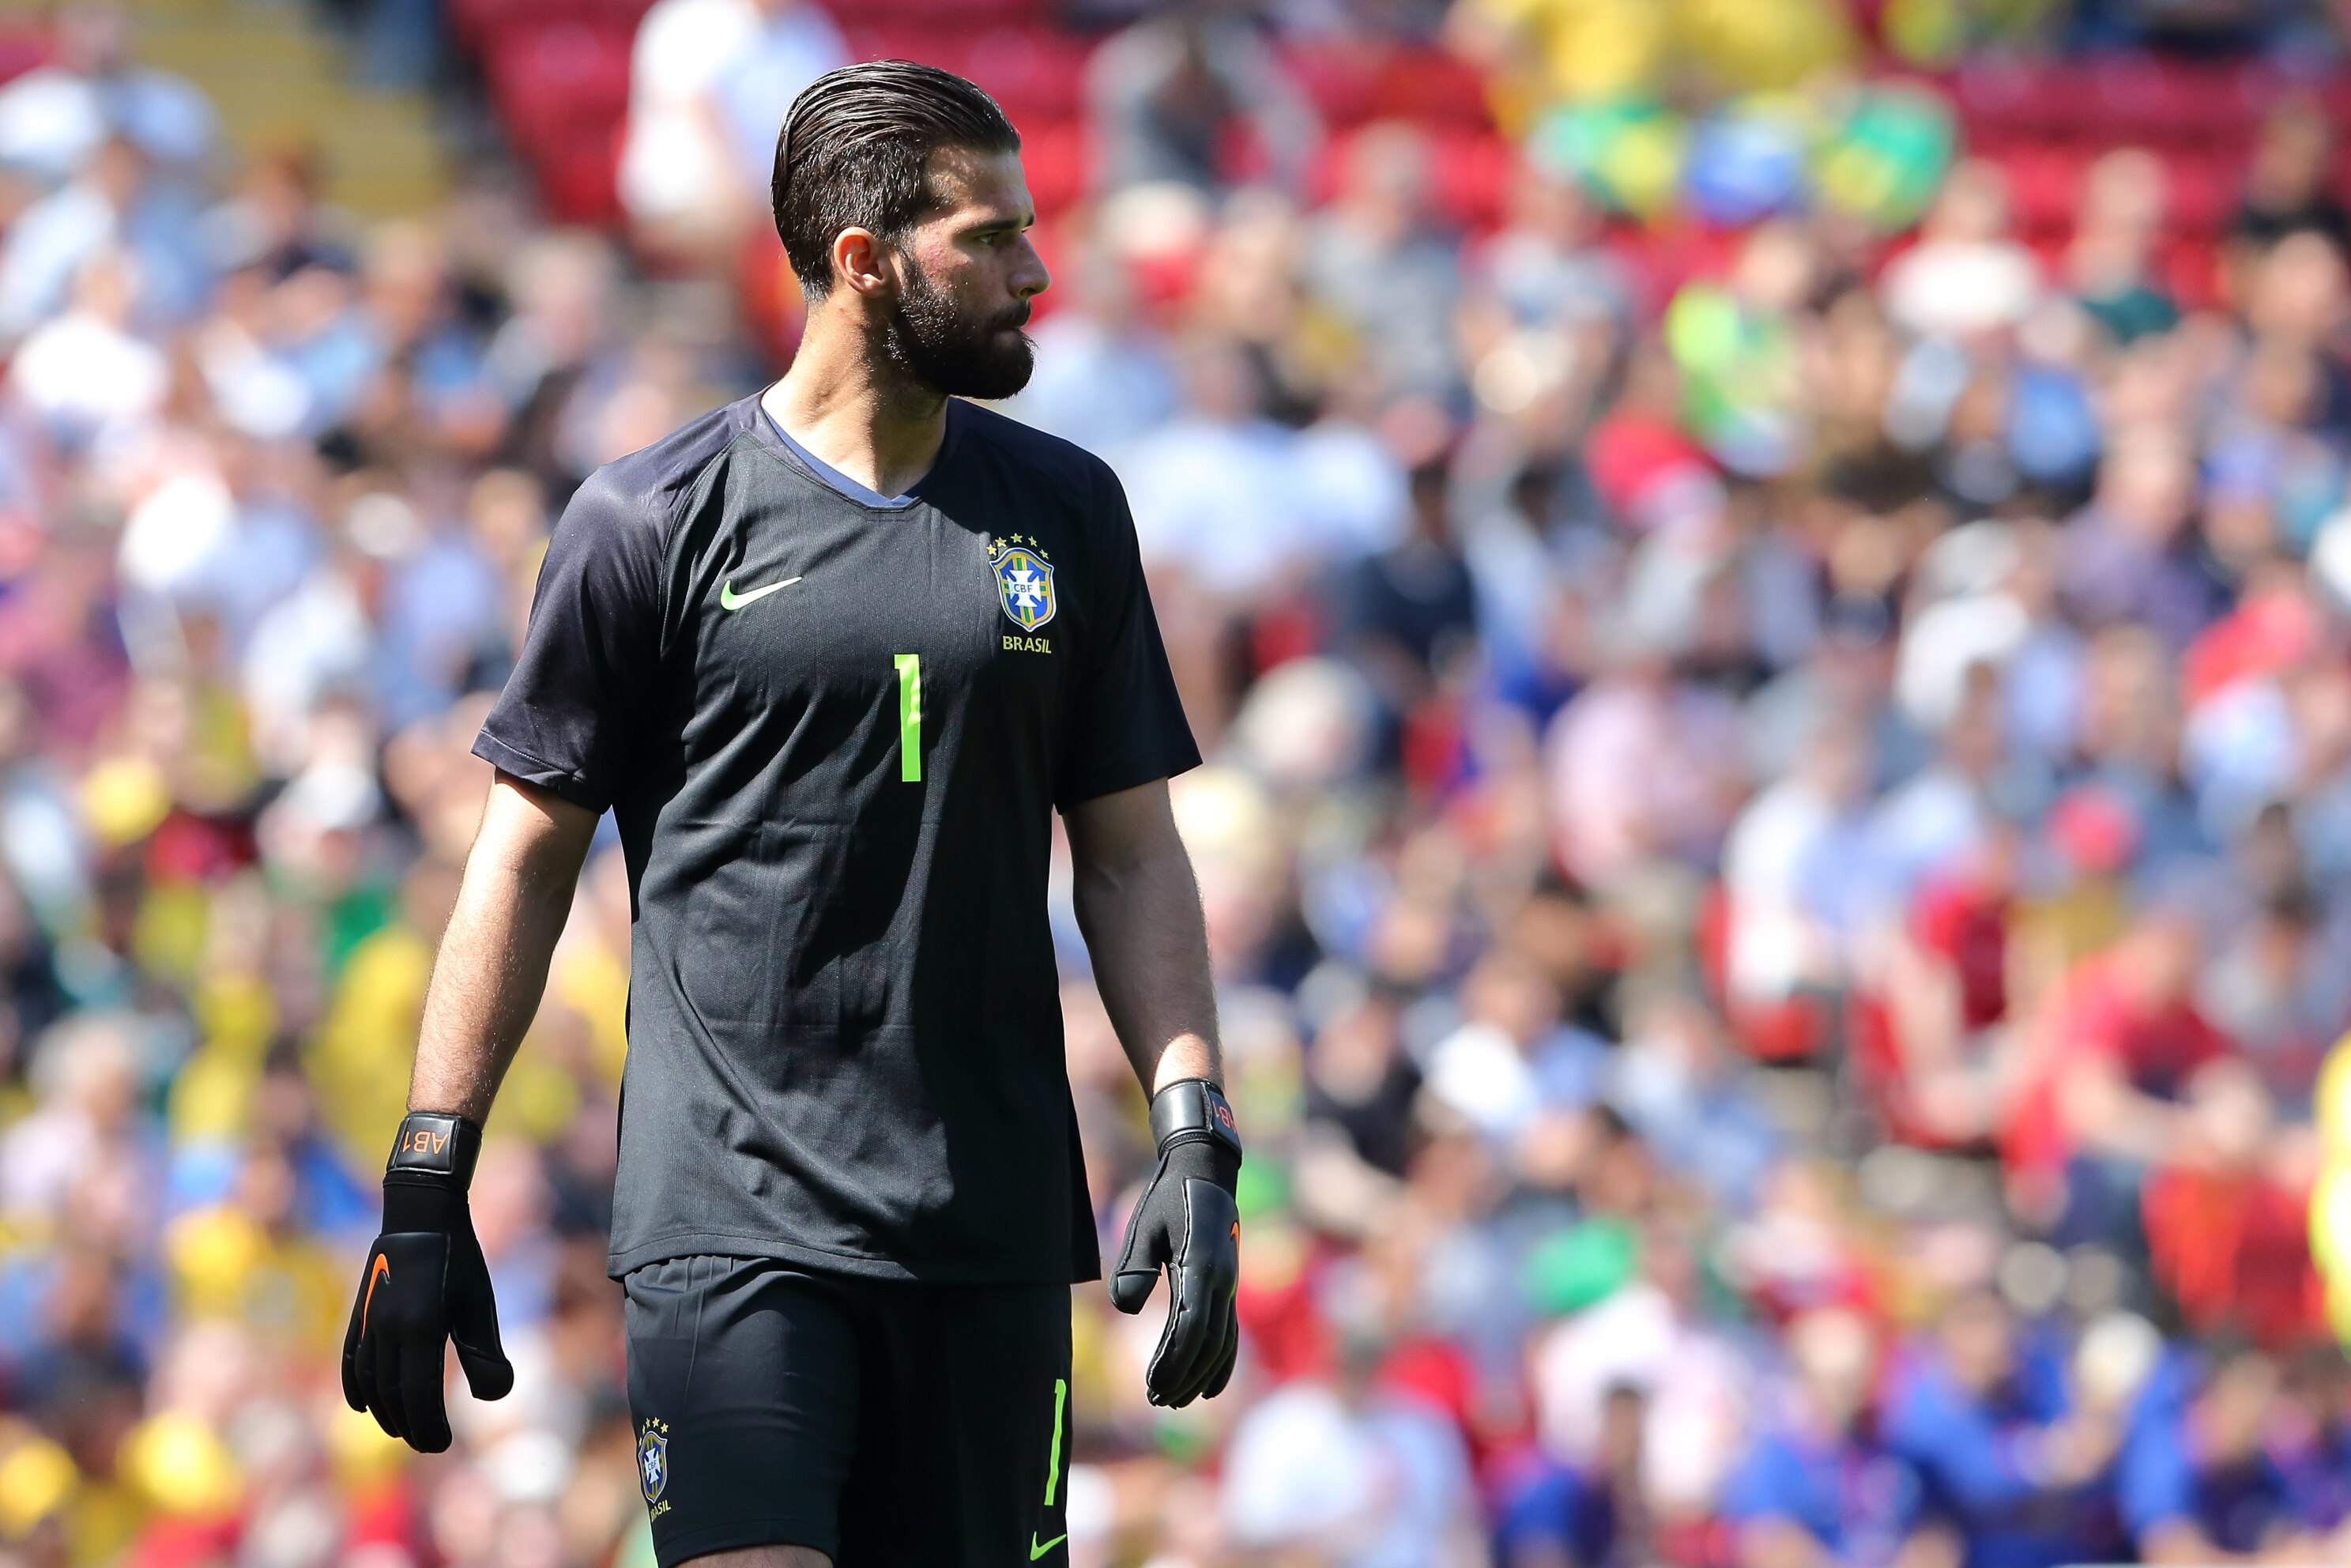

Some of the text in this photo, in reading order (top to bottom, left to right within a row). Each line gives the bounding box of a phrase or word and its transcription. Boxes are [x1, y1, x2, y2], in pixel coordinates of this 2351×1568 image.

[1014, 584, 1032, 593] CBF
[1003, 635, 1051, 654] BRASIL
[894, 654, 921, 782] 1
[401, 1130, 449, 1155] AB1
[1044, 1378, 1066, 1506] 1
[647, 1460, 657, 1471] CBF
